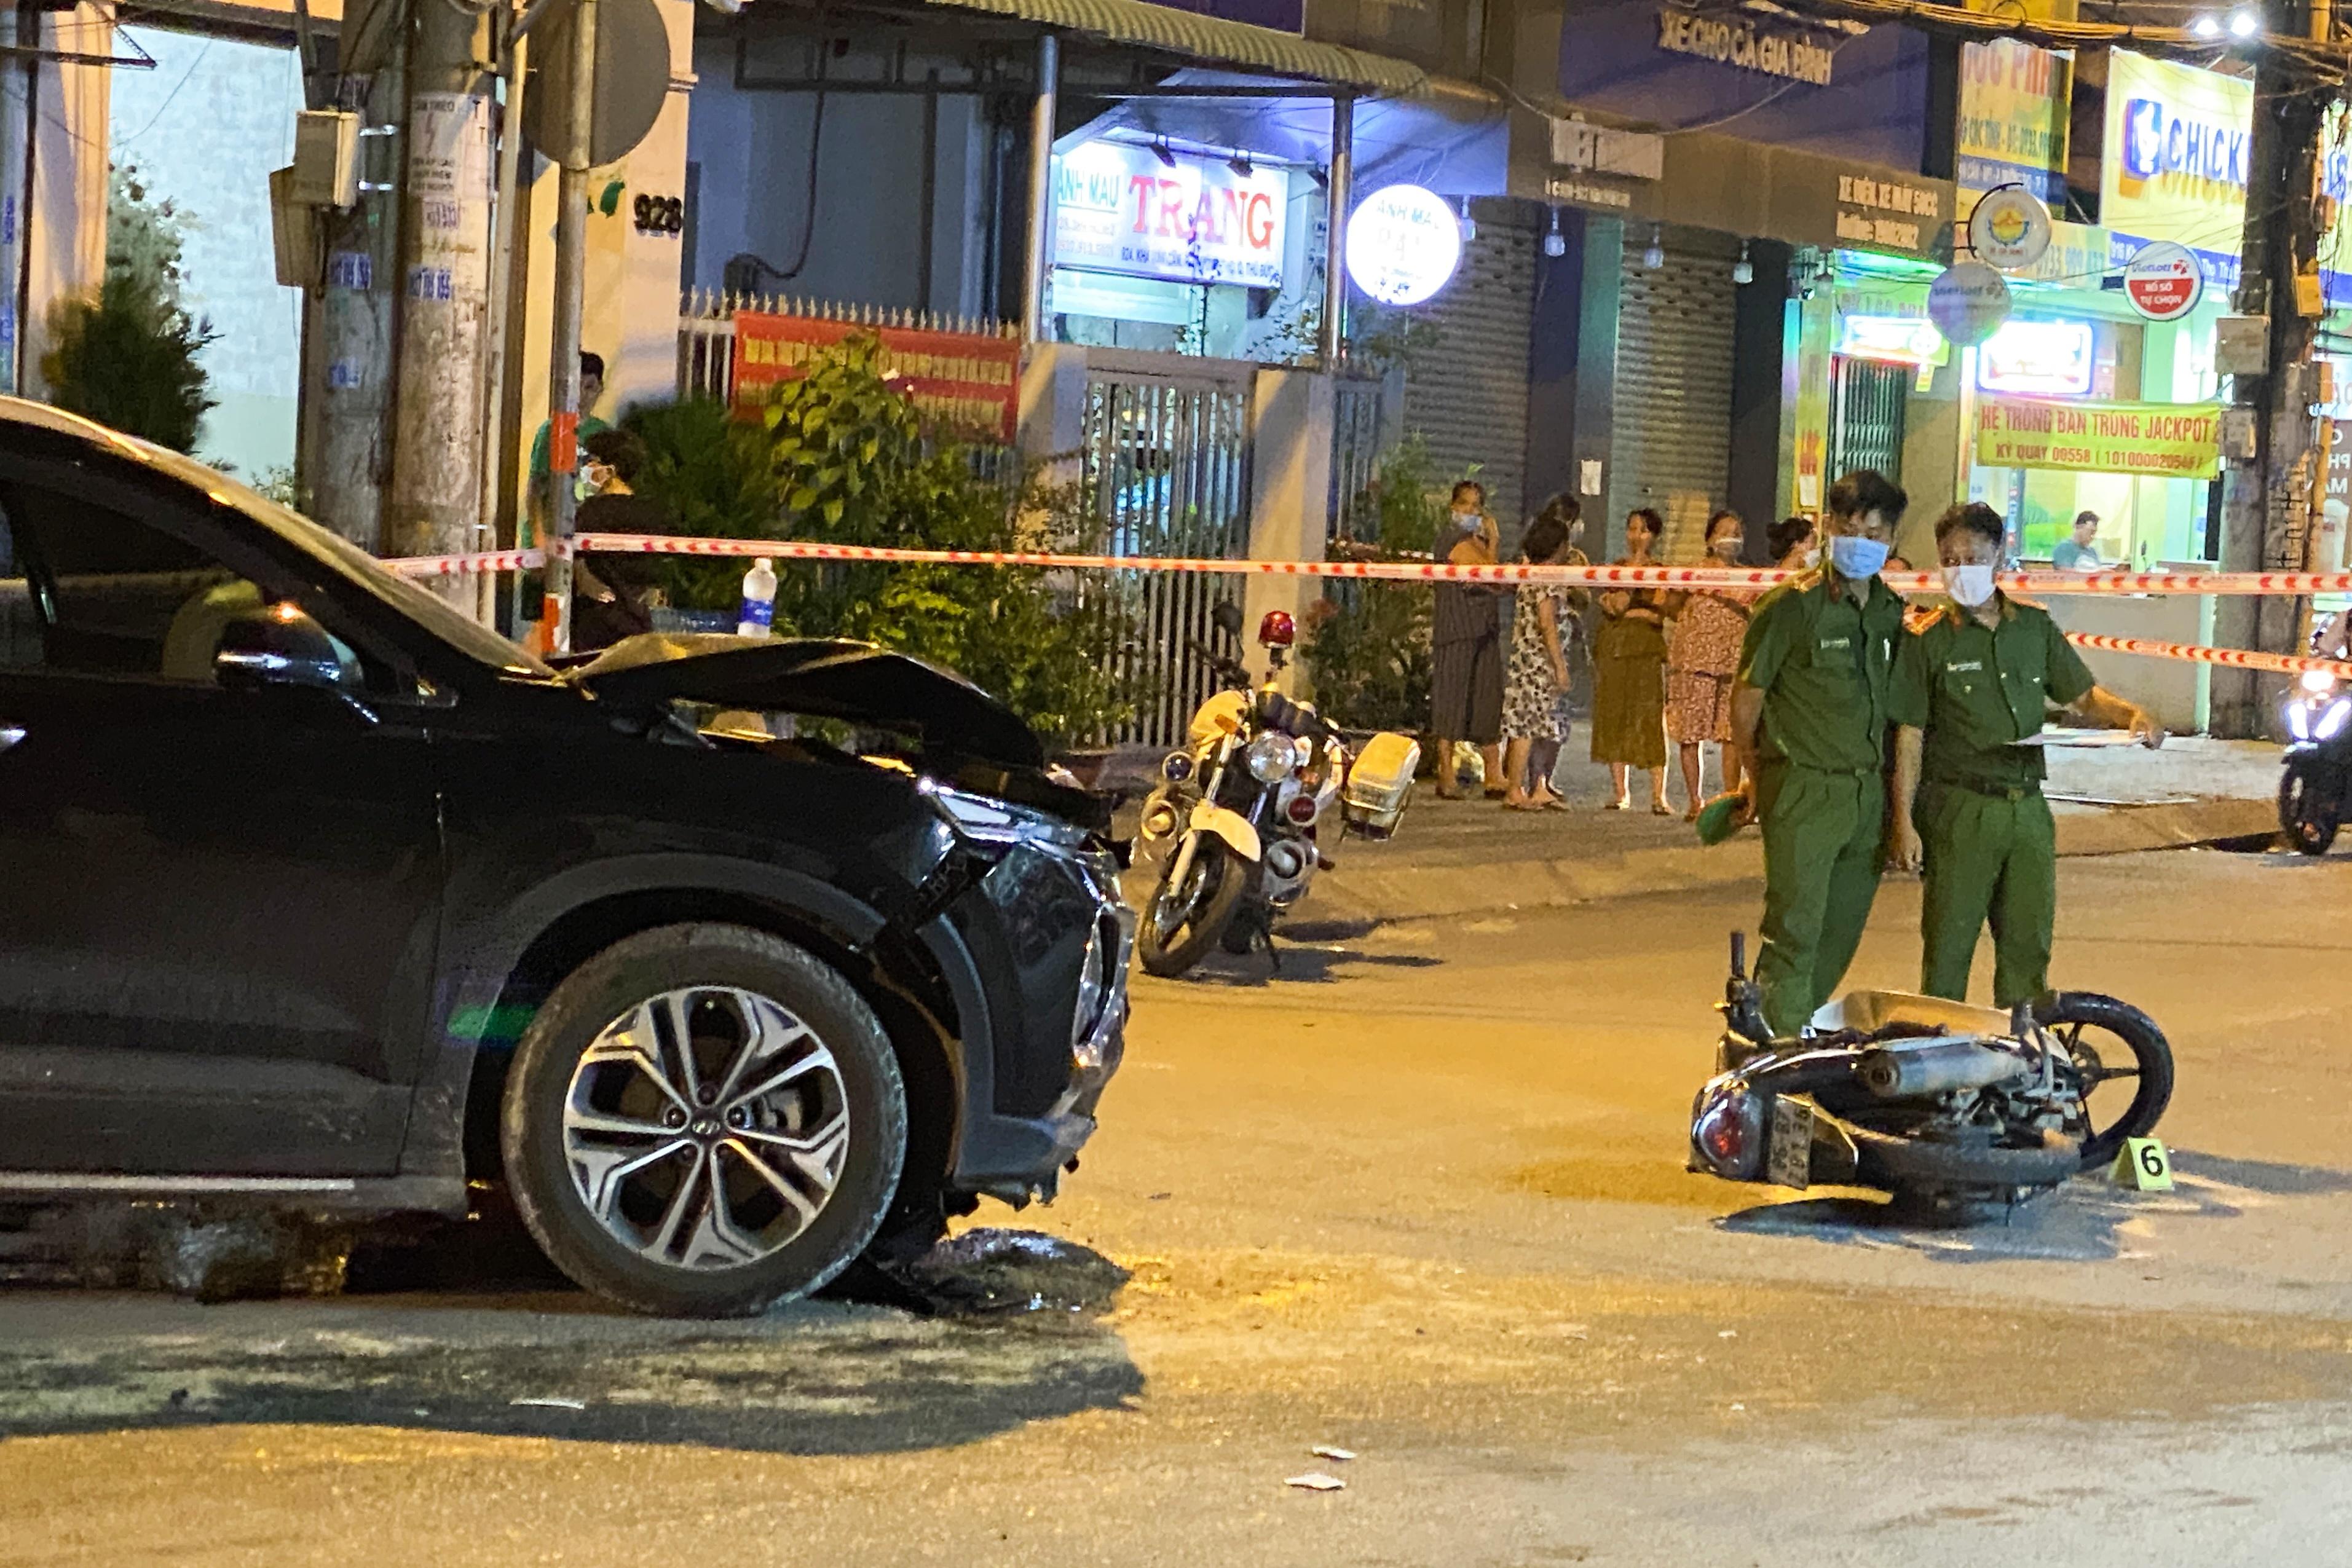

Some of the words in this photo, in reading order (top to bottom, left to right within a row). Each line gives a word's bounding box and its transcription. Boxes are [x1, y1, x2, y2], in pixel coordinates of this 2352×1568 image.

[2168, 116, 2253, 184] CHICK
[1129, 175, 1275, 251] TRANG
[2145, 416, 2212, 443] JACKPOT
[2141, 1145, 2163, 1177] 6
